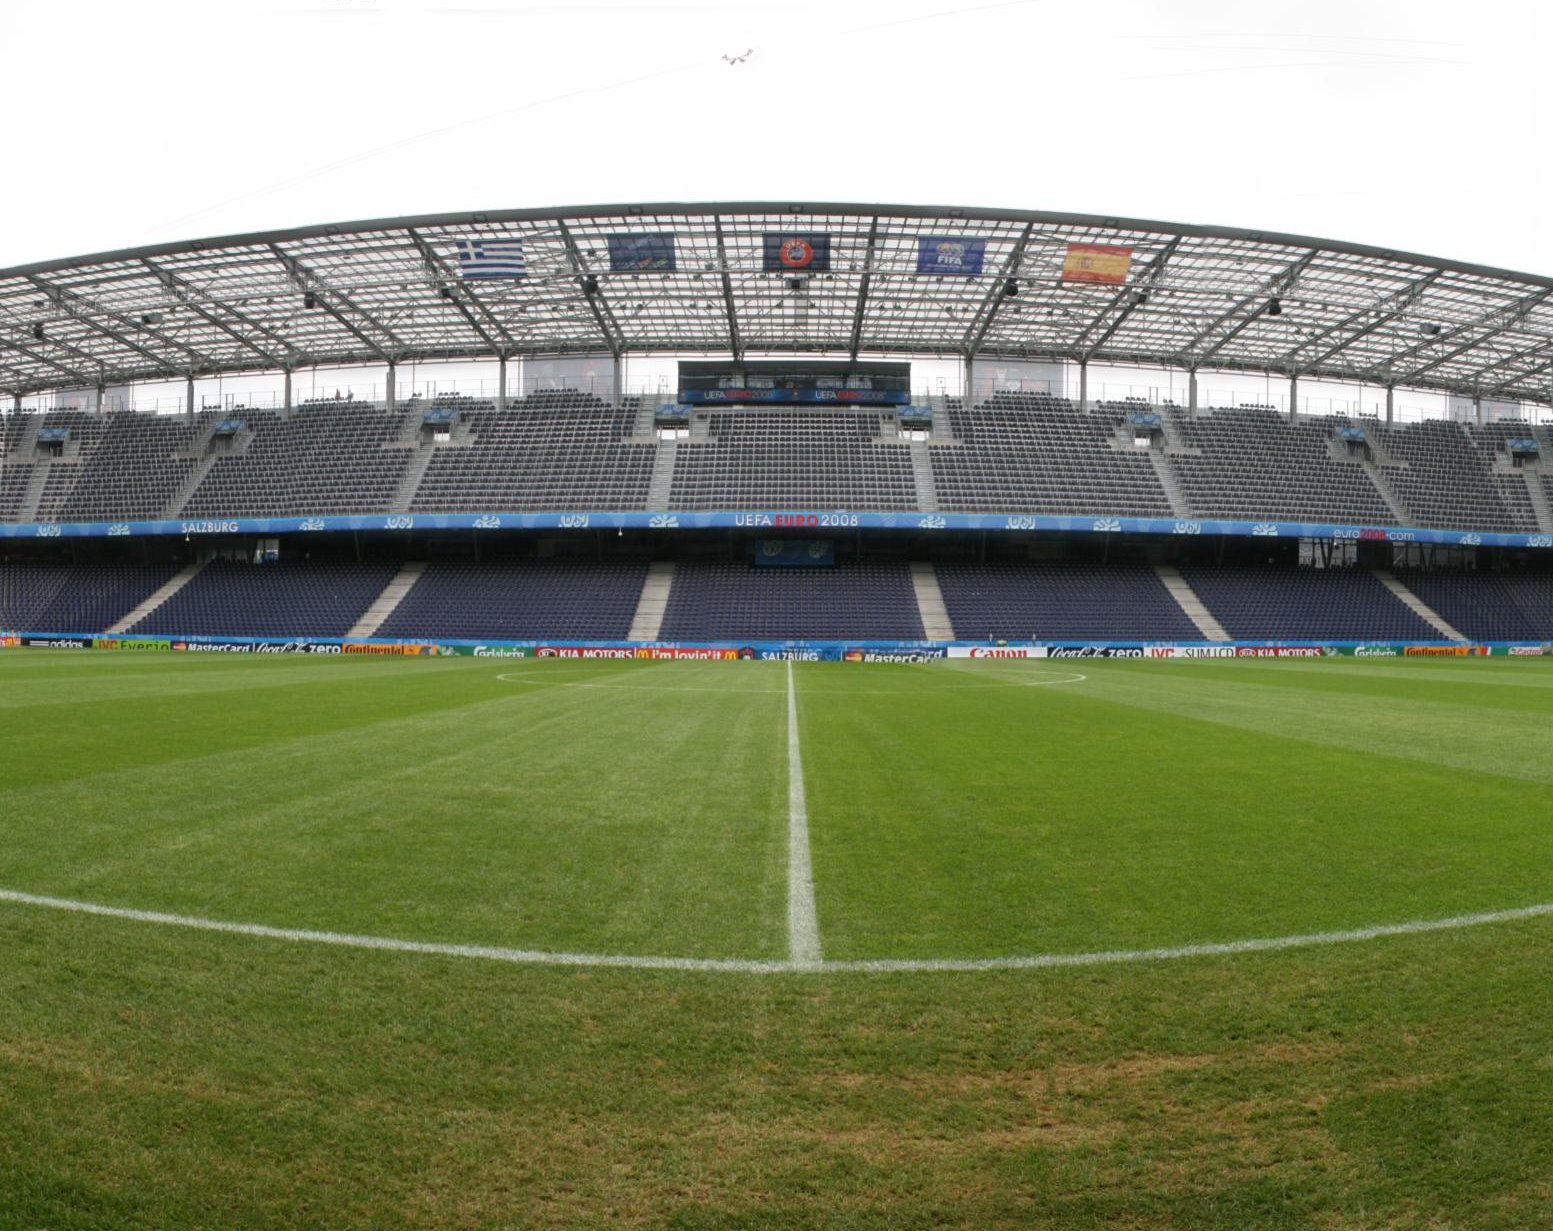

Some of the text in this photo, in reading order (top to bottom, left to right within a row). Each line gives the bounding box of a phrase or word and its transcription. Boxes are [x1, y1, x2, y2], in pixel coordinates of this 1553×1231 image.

[937, 256, 963, 266] FIFA
[704, 391, 726, 401] UEFA
[816, 390, 839, 400] UEFA
[735, 514, 858, 527] UEFA EURO 2008
[181, 521, 239, 533] SALZBURG
[50, 640, 83, 648] adidas
[188, 643, 250, 653] MasterCard
[309, 643, 341, 654] zero
[344, 644, 405, 655] Continental
[473, 646, 525, 657] Carlsberg
[559, 648, 580, 658] KIA
[582, 648, 633, 659] MOTORS
[761, 651, 819, 662] SALZBURG
[969, 647, 1028, 659] Canon
[1108, 648, 1143, 659] zero
[1257, 648, 1275, 658] KIA
[1277, 648, 1321, 658] MOTORS
[1354, 647, 1397, 657] Carlsberg
[1406, 648, 1456, 657] Continental
